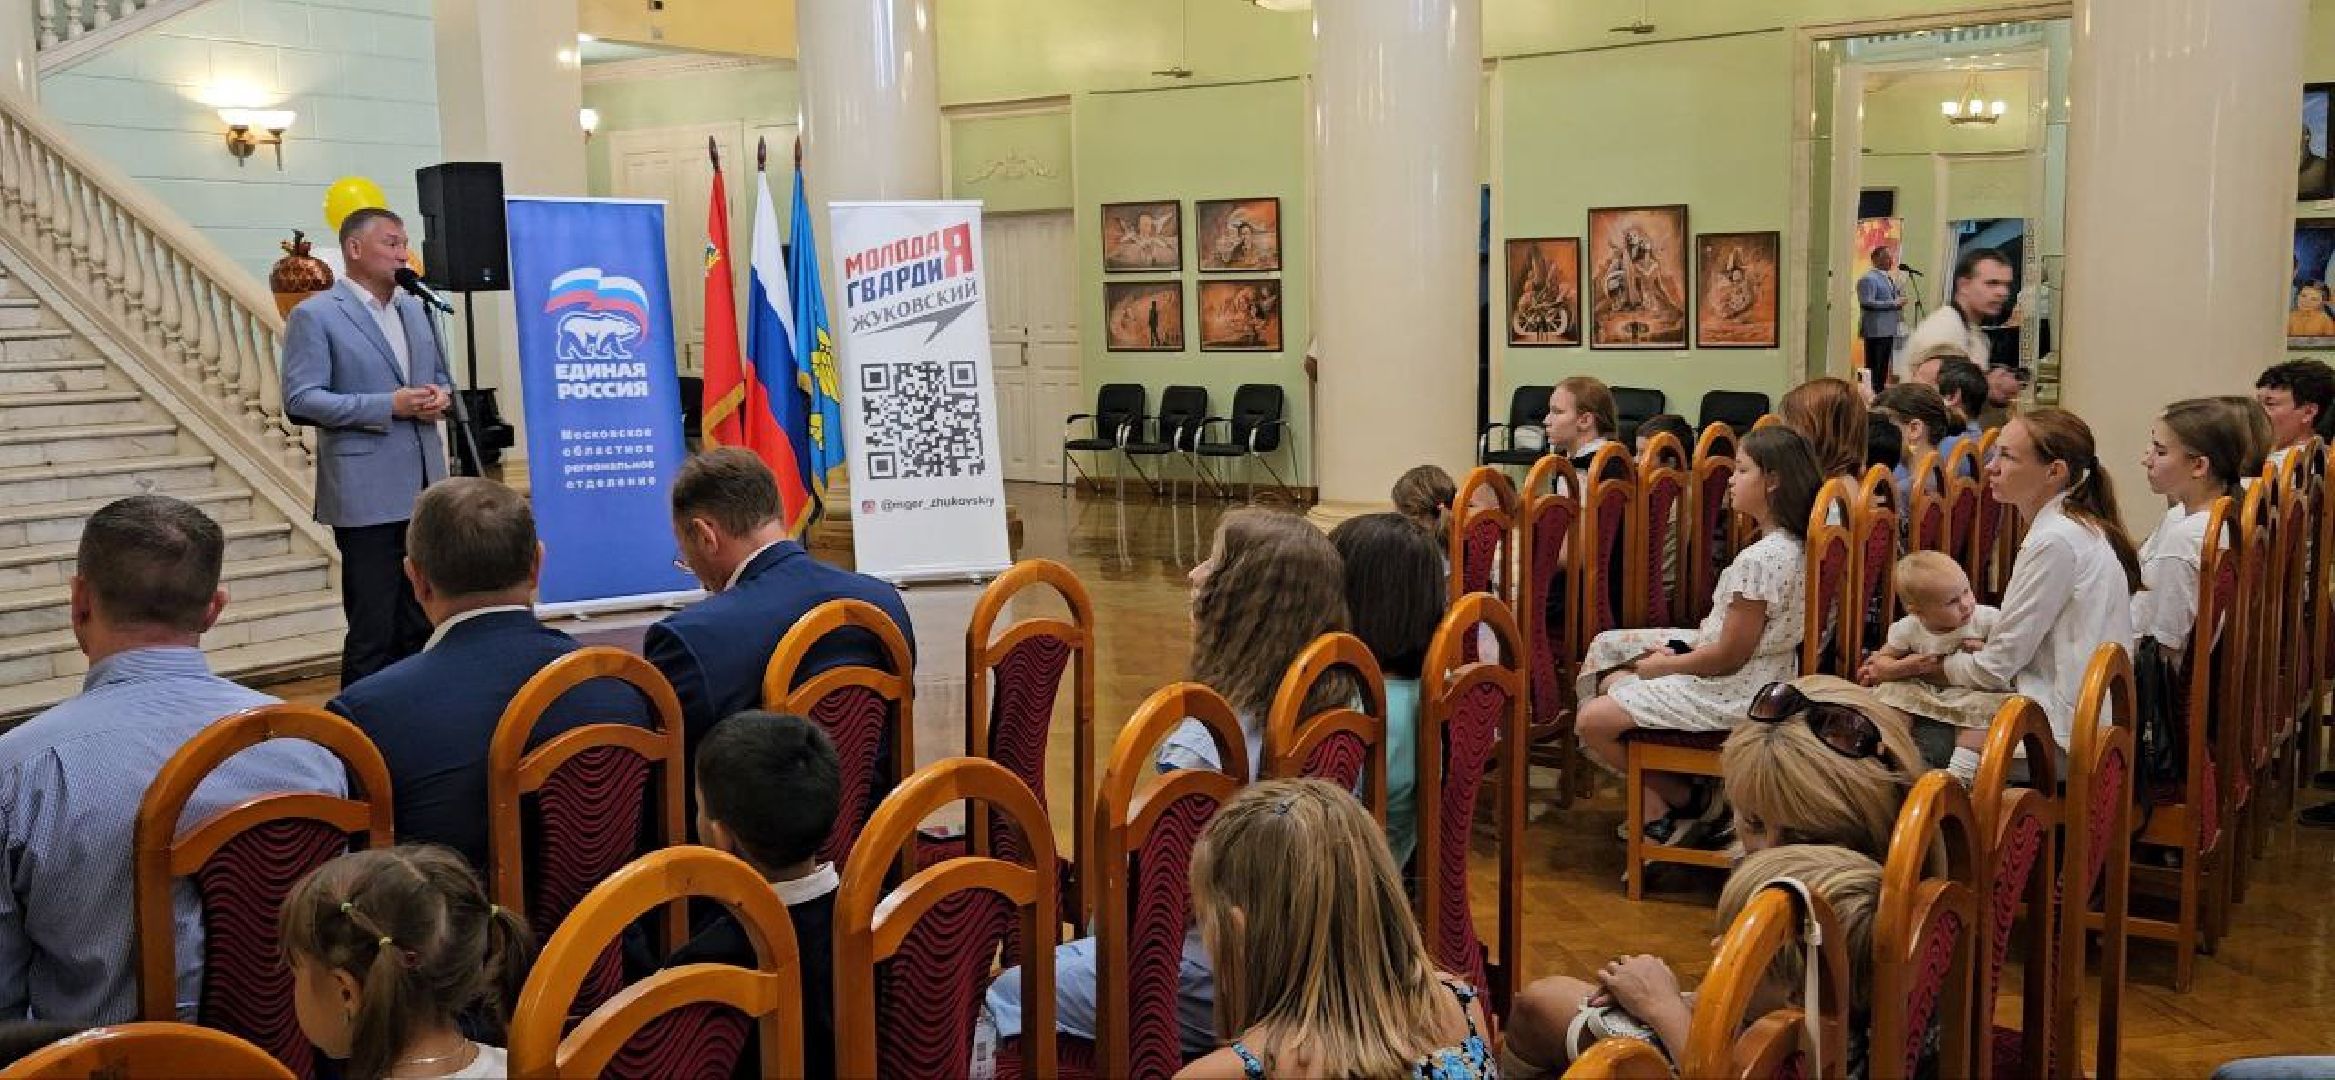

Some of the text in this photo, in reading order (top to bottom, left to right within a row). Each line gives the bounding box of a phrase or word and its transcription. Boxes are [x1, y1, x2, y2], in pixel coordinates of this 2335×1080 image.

[851, 277, 978, 334] ЖУКОВСКИЙ
[555, 362, 647, 382] ЕДИНАЯ
[557, 380, 649, 400] РОССИЯ
[560, 428, 652, 440] Московское
[562, 445, 654, 457] областное
[564, 460, 655, 476] региональное
[566, 476, 656, 489] отделение
